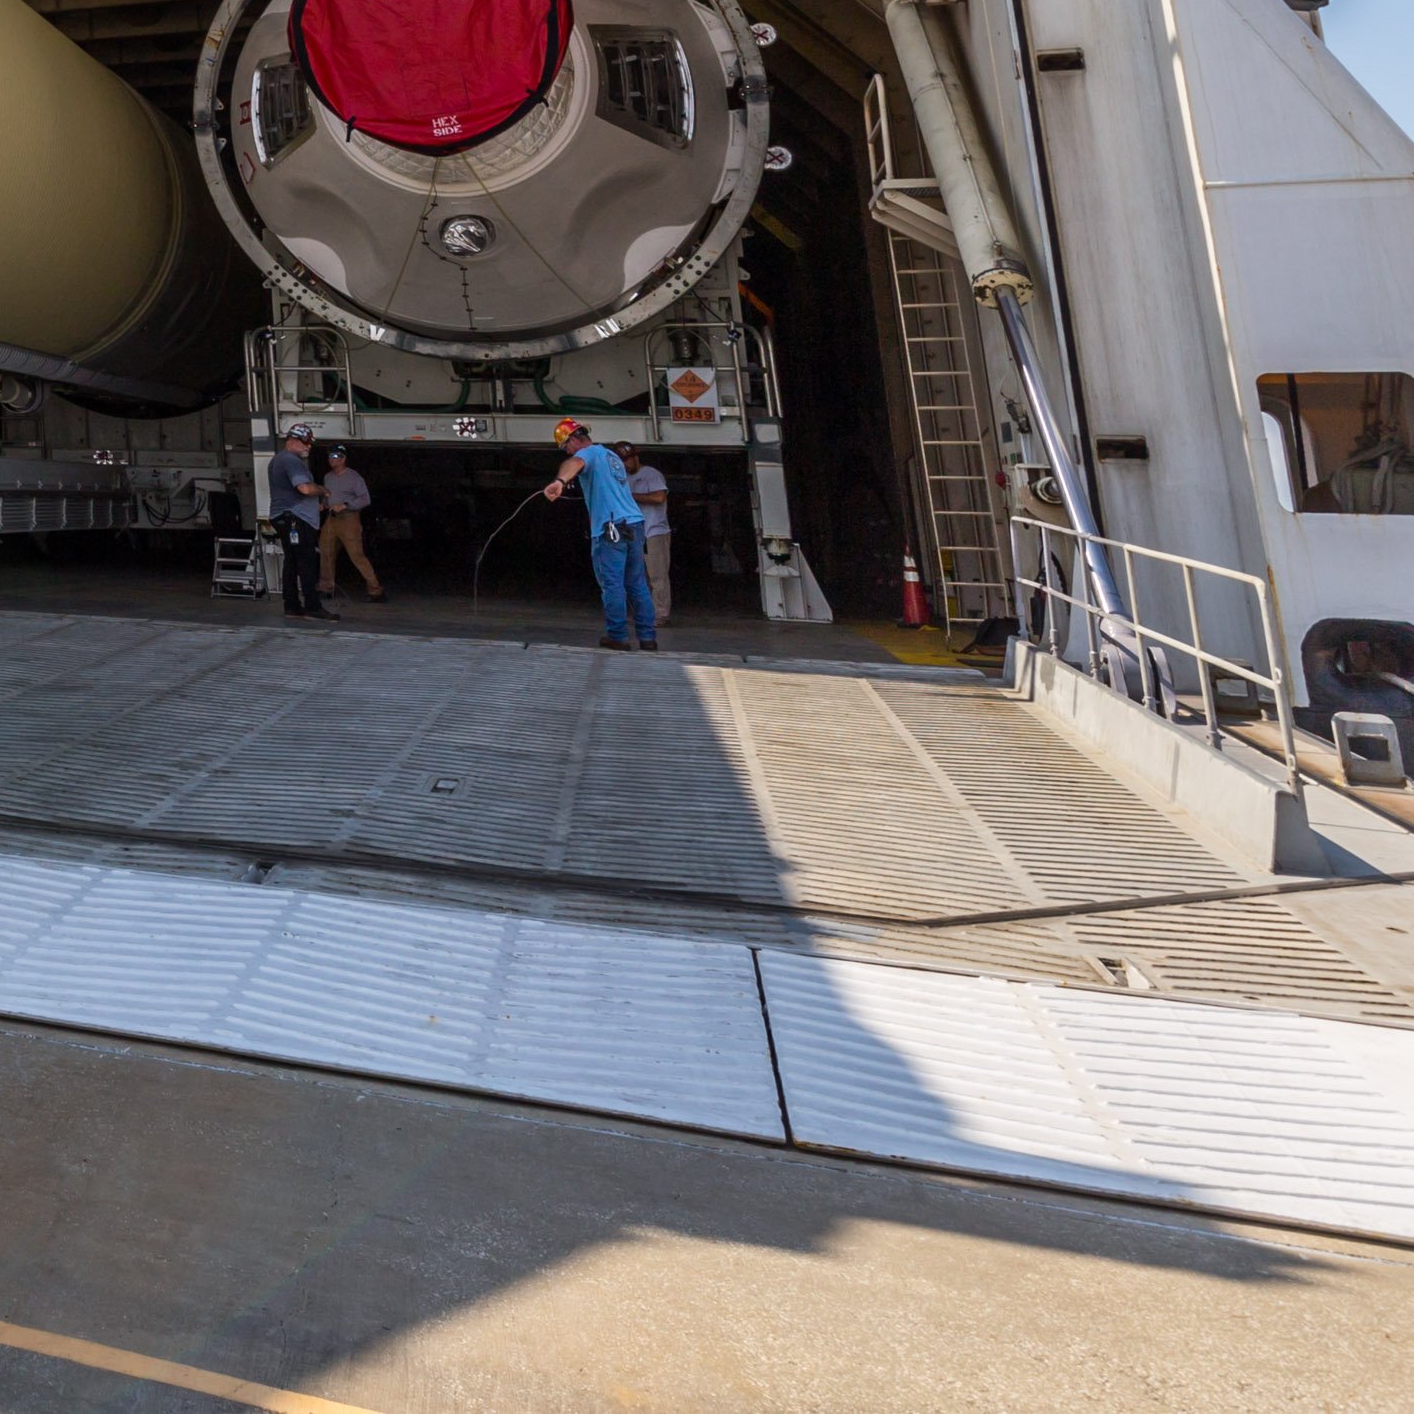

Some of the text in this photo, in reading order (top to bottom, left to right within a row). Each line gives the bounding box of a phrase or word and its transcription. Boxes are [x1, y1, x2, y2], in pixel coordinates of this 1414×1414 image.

[432, 115, 459, 128] HEX
[433, 124, 463, 137] SIDE
[674, 408, 712, 420] 0349
